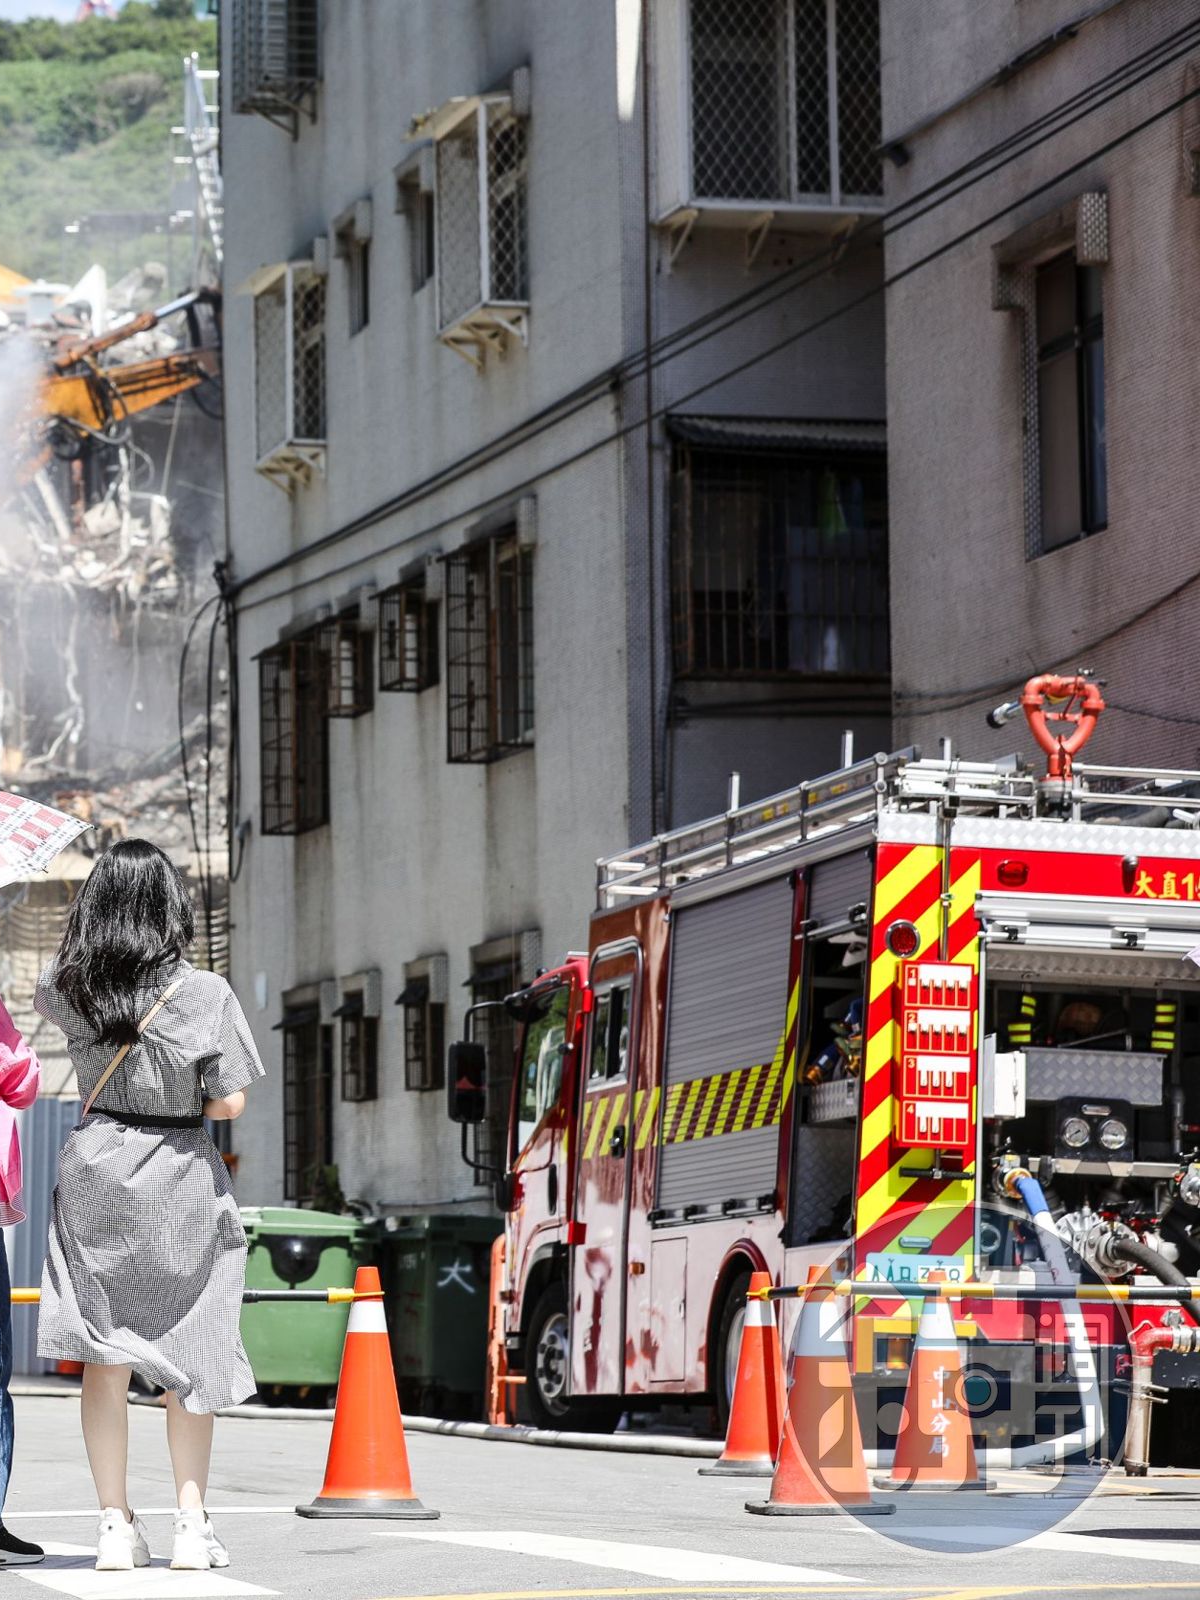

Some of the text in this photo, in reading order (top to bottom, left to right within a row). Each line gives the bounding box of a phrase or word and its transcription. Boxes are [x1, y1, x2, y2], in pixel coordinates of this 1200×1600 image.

[1135, 870, 1200, 901] 大直1
[928, 1365, 952, 1457] 中山分局
